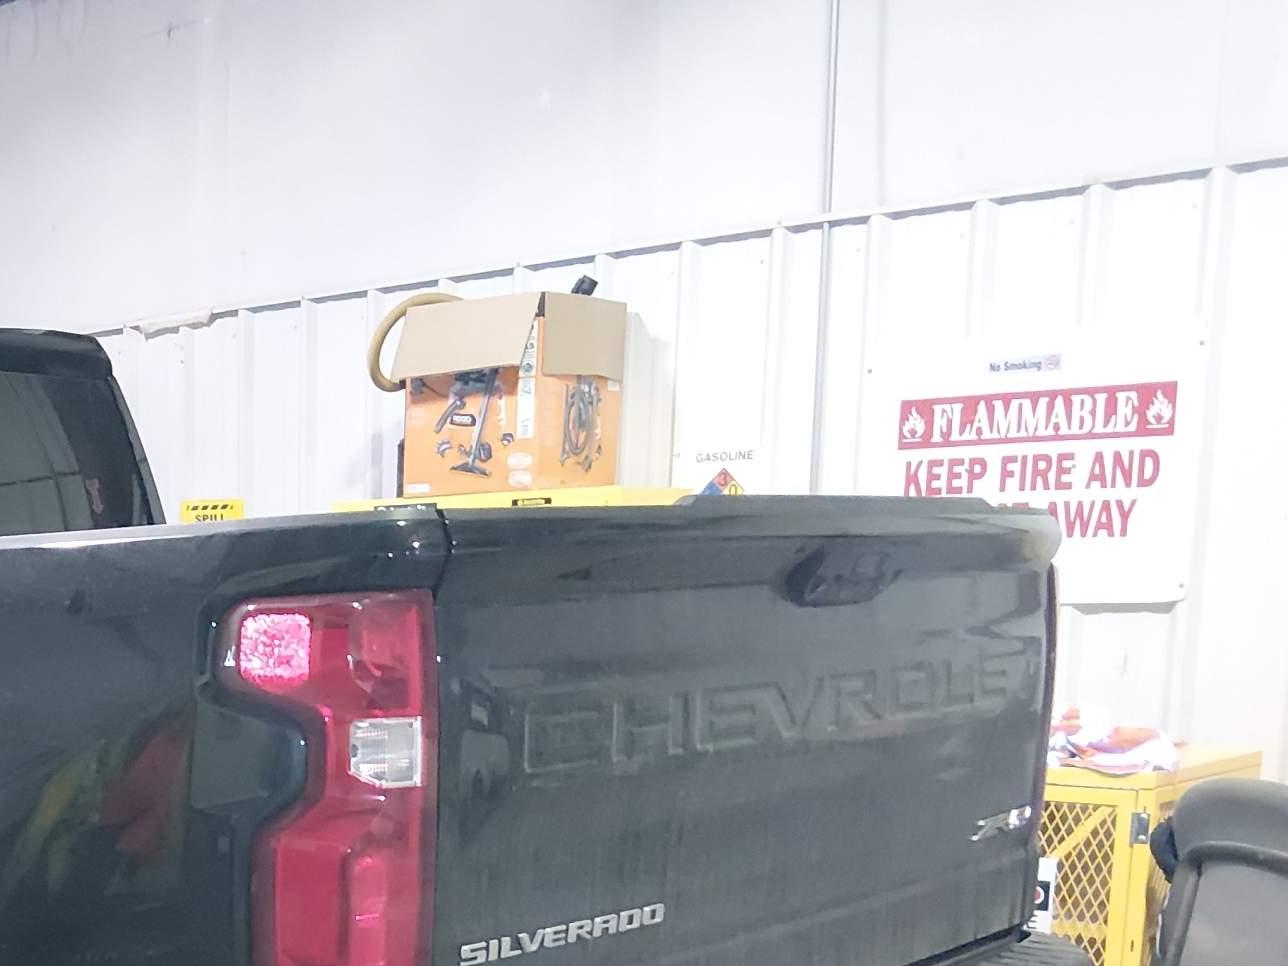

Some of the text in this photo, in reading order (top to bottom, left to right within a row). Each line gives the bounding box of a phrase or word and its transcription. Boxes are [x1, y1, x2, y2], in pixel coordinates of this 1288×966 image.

[930, 391, 1139, 442] FLAMMABLE
[695, 450, 754, 463] GASOLINE
[903, 448, 1161, 497] KEEP FIRE AND
[522, 658, 1034, 774] CHEVROLE
[459, 903, 665, 966] SILVERADO
